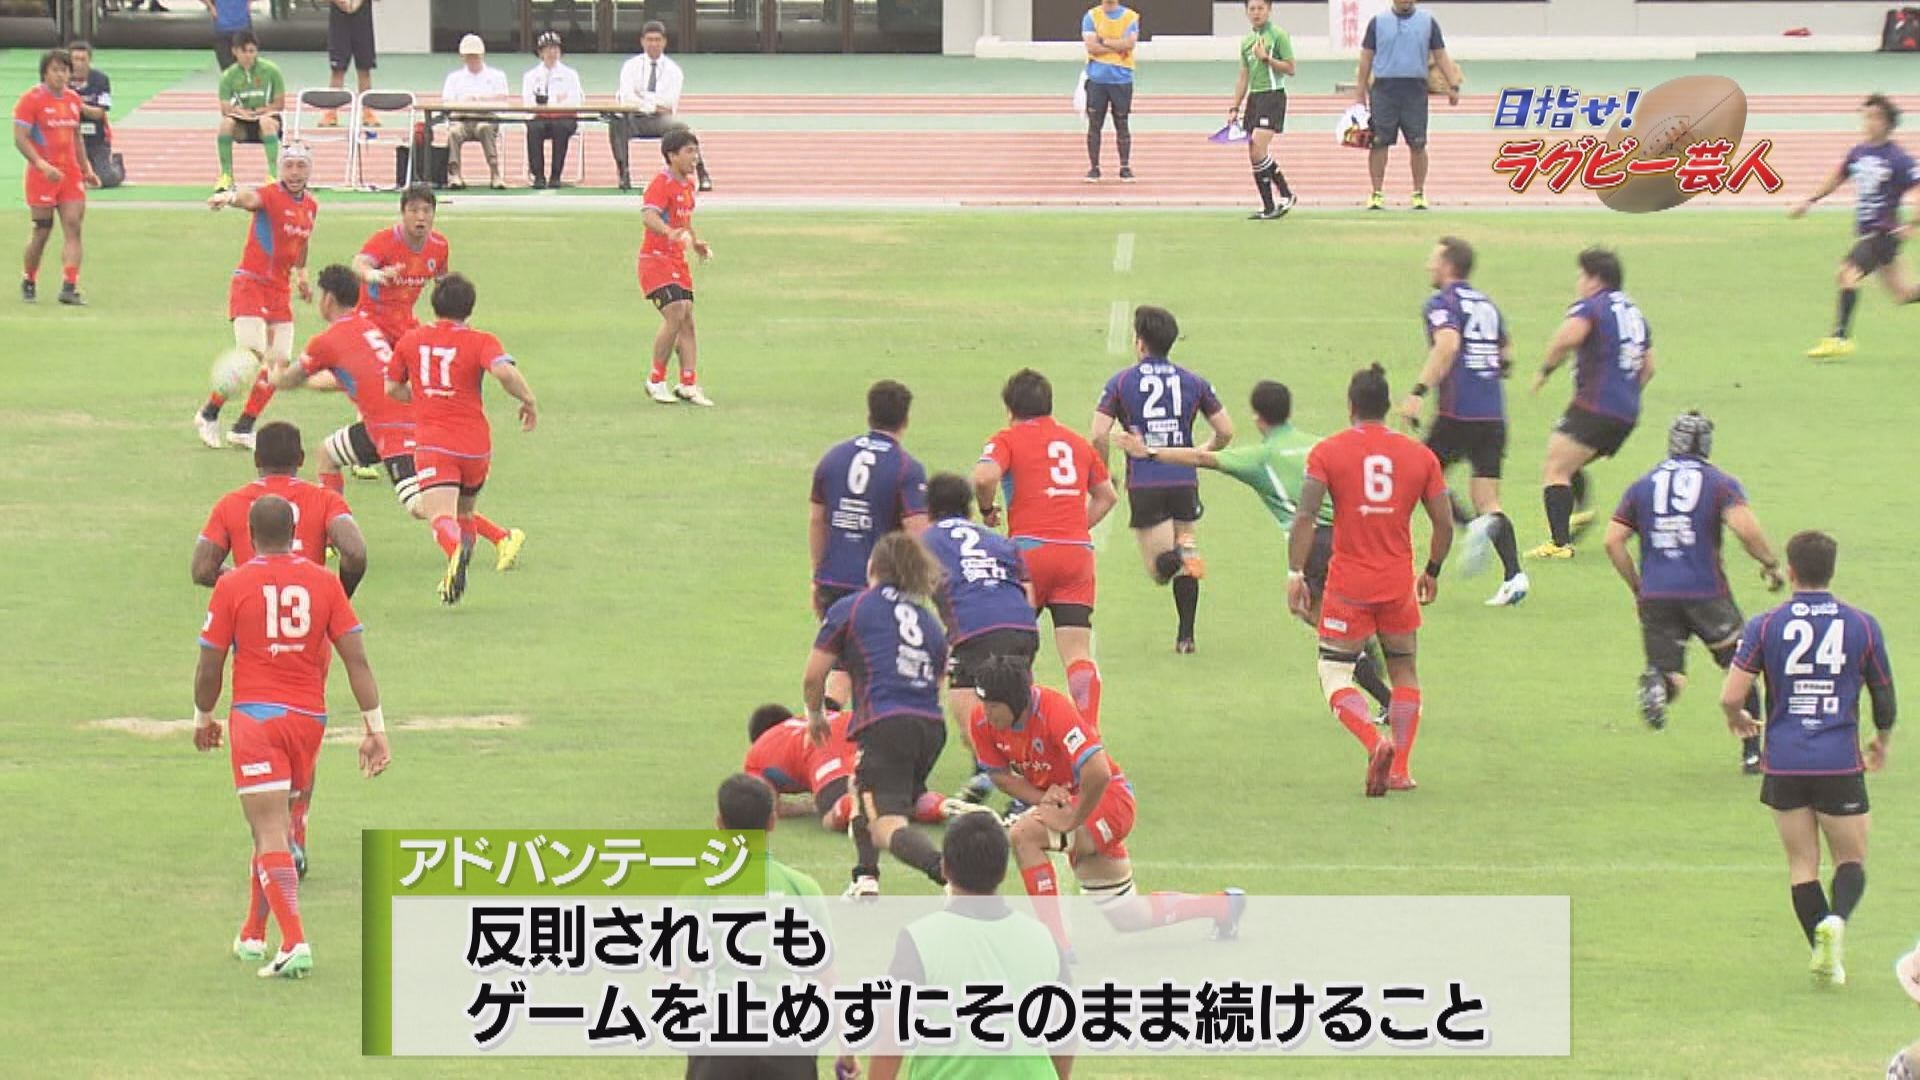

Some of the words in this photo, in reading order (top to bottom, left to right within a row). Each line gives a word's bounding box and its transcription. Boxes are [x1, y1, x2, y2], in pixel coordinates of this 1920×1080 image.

[363, 329, 393, 363] 5
[419, 344, 457, 387] 17
[1139, 374, 1182, 418] 21
[847, 450, 876, 495] 6
[1047, 440, 1077, 485] 3
[1363, 454, 1393, 502] 6
[1652, 469, 1703, 514] 19
[950, 526, 987, 558] 2
[263, 585, 311, 638] 13
[894, 603, 924, 647] 8
[1783, 619, 1847, 674] 24
